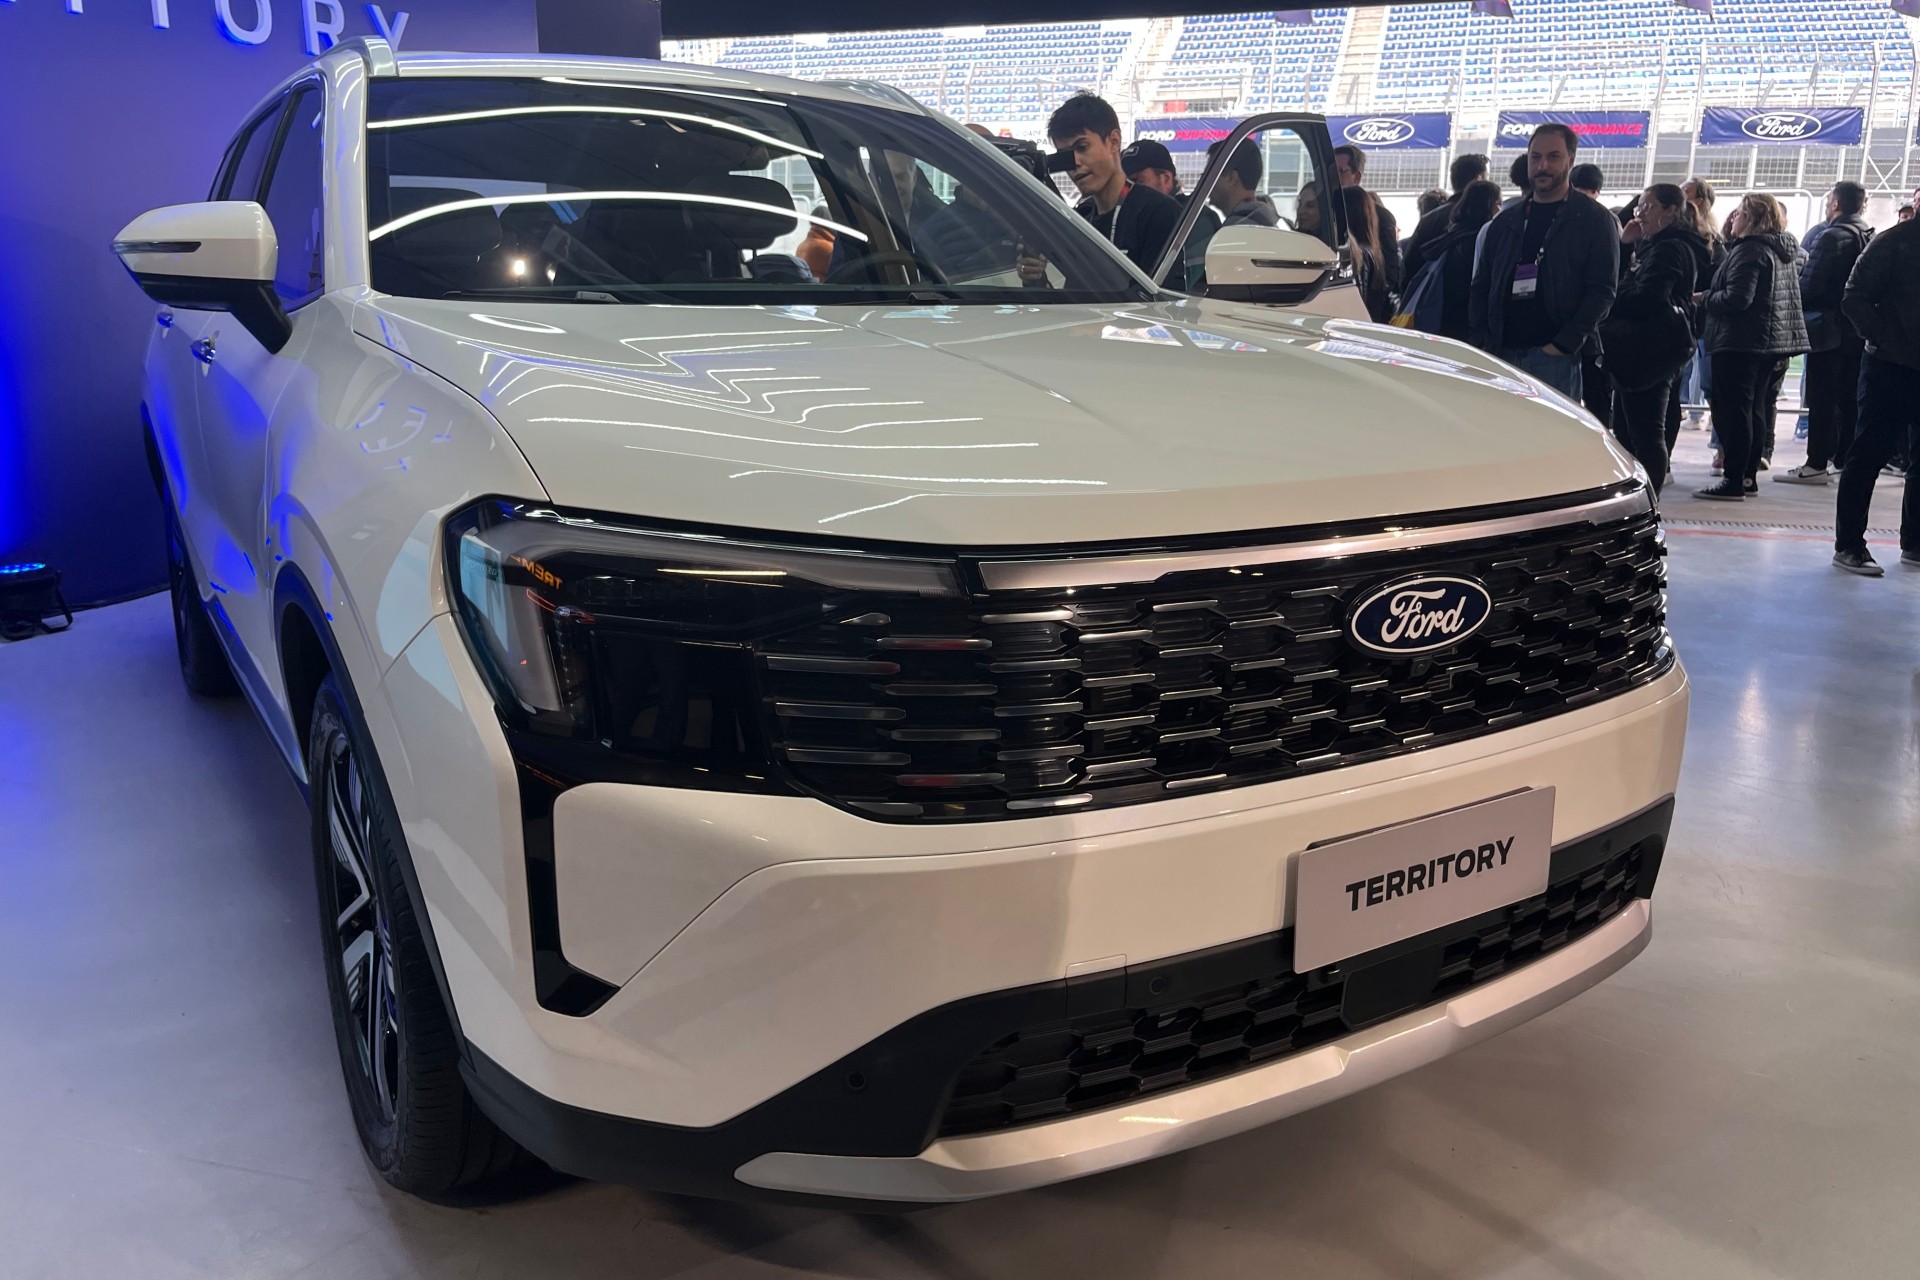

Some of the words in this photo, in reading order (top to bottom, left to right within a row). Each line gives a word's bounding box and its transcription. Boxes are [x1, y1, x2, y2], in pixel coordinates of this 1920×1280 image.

[1356, 121, 1402, 141] Ford
[1501, 123, 1541, 136] FOR
[1756, 115, 1807, 136] Ford
[1138, 130, 1176, 142] FORD
[1380, 587, 1466, 644] Ford
[1345, 836, 1515, 912] TERRITORY
